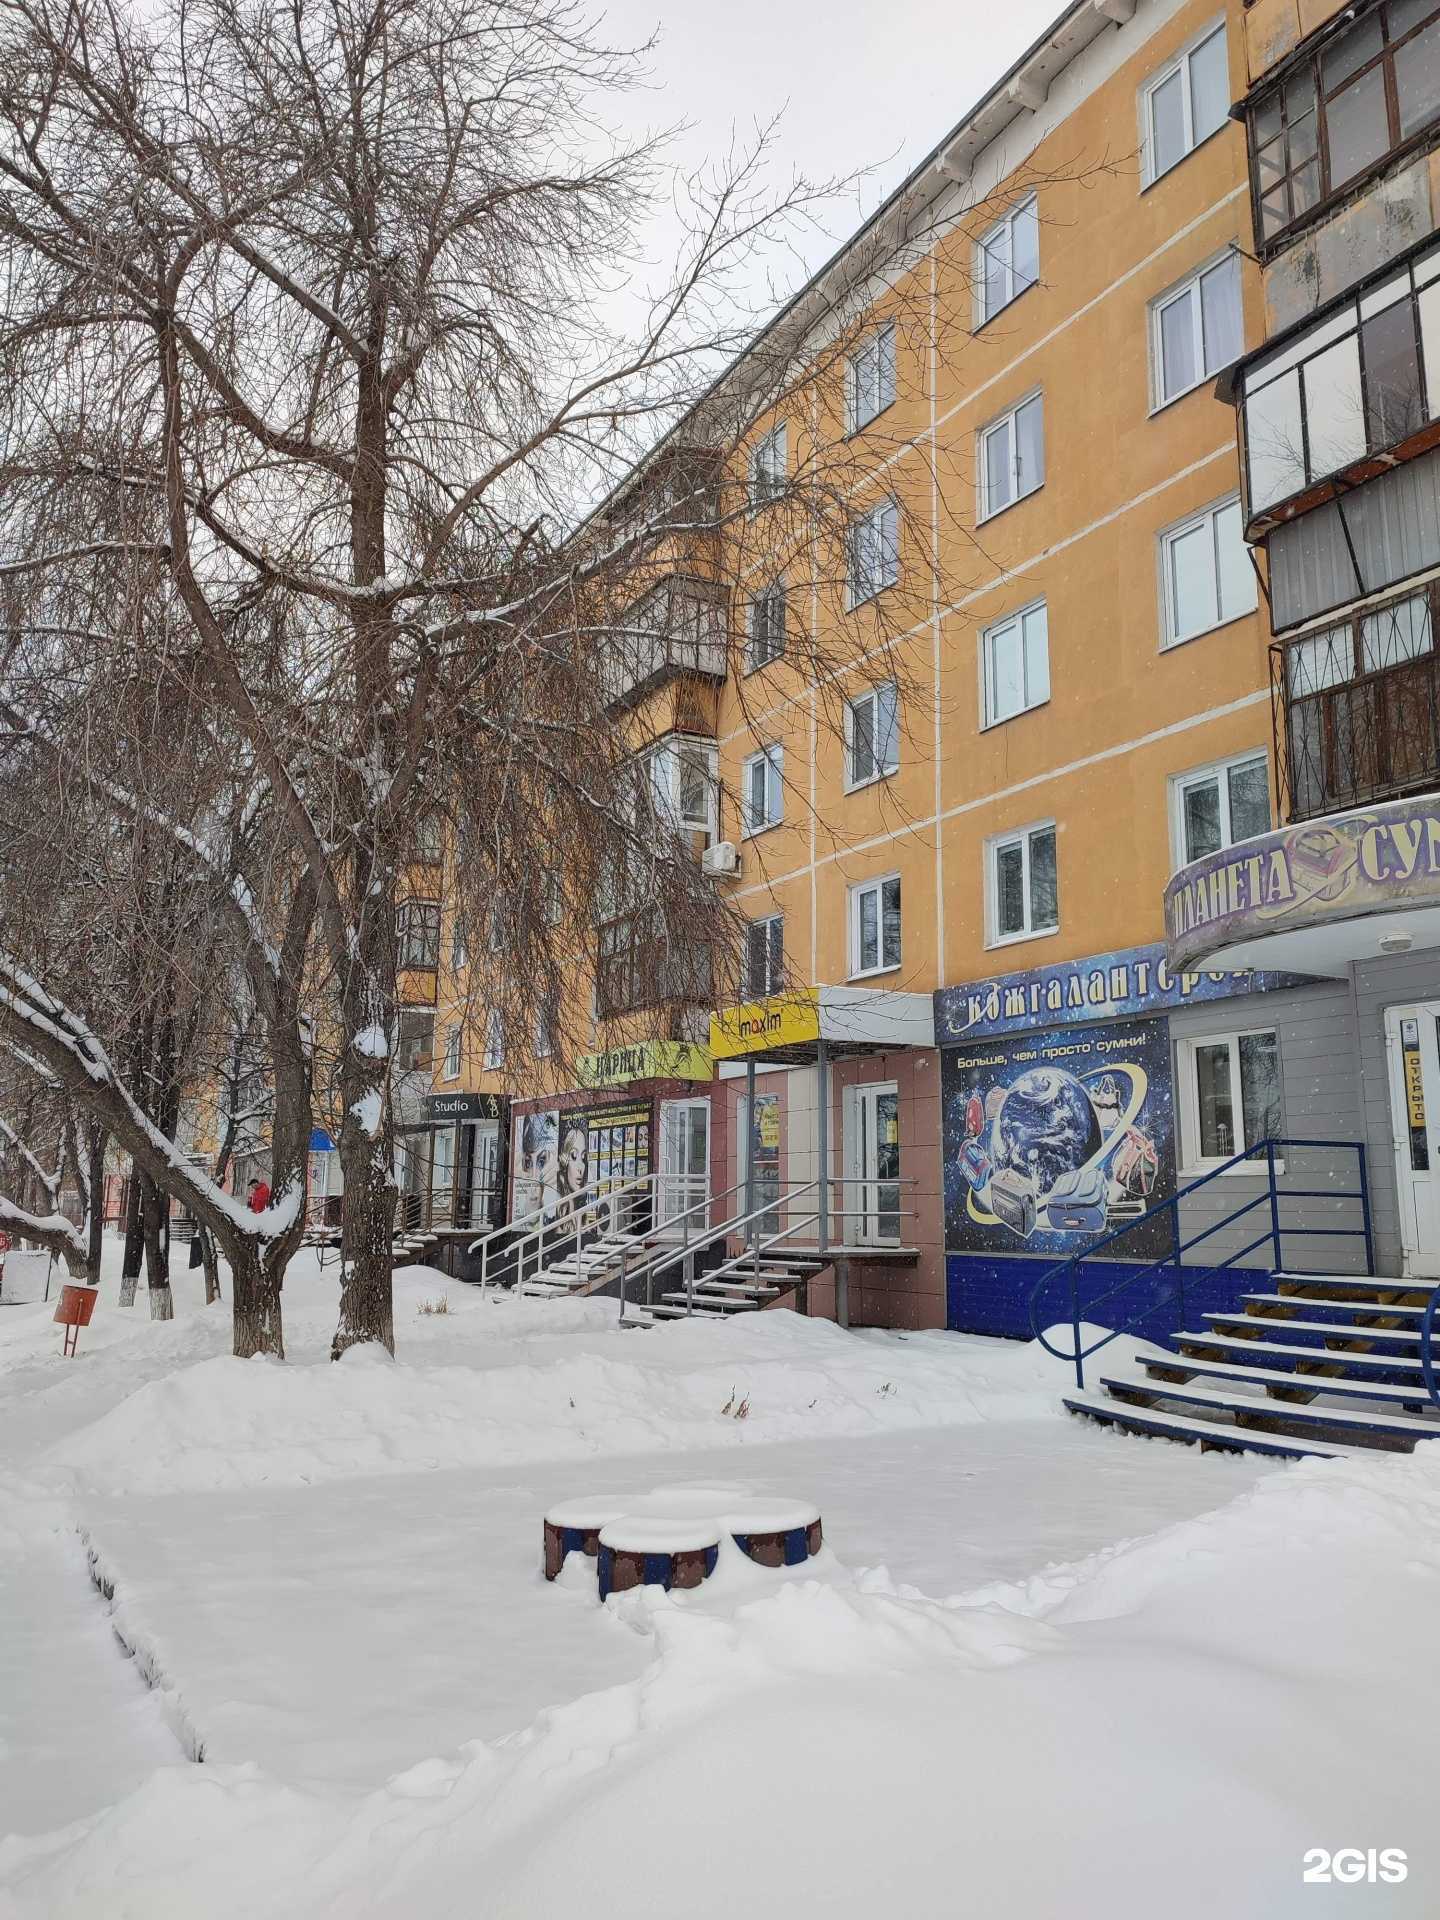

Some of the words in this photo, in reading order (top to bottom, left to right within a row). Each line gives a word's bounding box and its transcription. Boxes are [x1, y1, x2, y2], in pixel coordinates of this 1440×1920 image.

[1174, 849, 1294, 939] ПЛАНЕТА
[740, 1010, 782, 1037] maxim
[957, 1054, 1007, 1069] Больше,
[1012, 1050, 1037, 1062] чем
[1042, 1042, 1091, 1060] просто
[1096, 1032, 1146, 1053] сумки!
[435, 1100, 469, 1112] Studio
[1410, 1058, 1425, 1120] ОТКРЫТО
